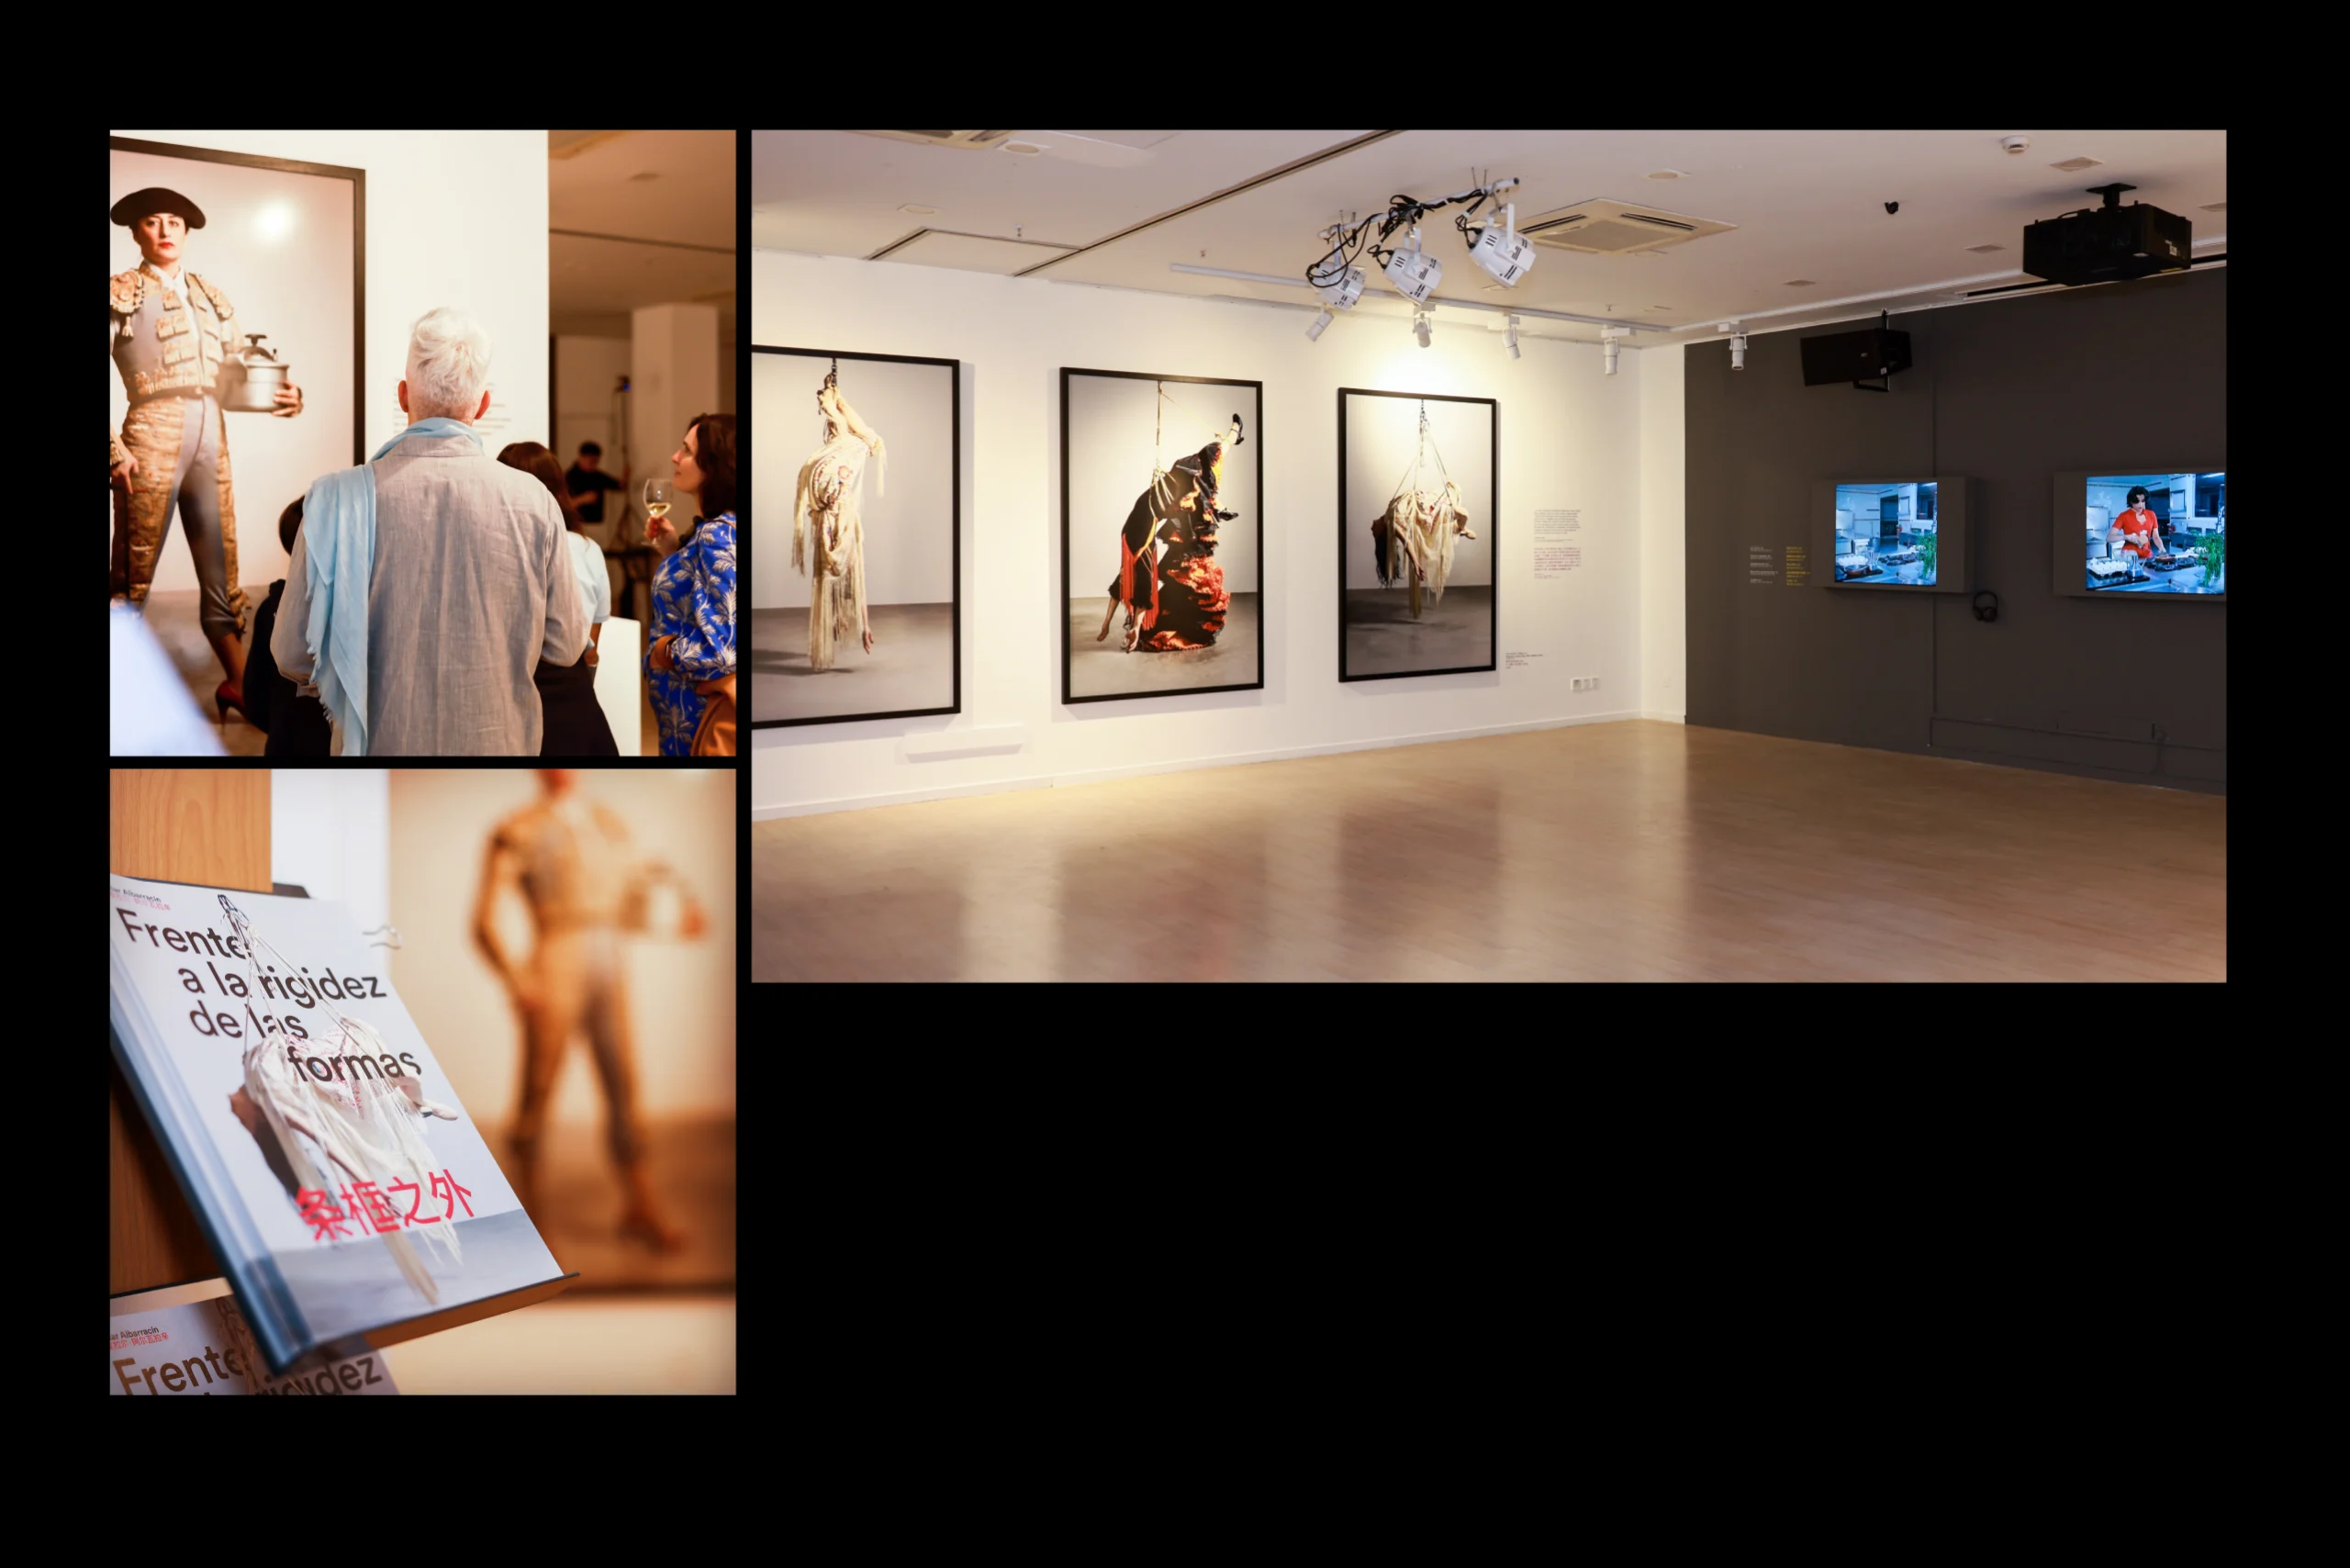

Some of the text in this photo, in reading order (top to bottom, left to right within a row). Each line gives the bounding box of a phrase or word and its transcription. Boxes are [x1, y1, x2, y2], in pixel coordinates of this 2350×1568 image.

[116, 907, 252, 959] Frente
[177, 961, 387, 1009] a la rigidez
[189, 1000, 308, 1040] de las
[287, 1046, 422, 1082] formas
[295, 1169, 475, 1242] 条框之外
[112, 1346, 244, 1395] Frente
